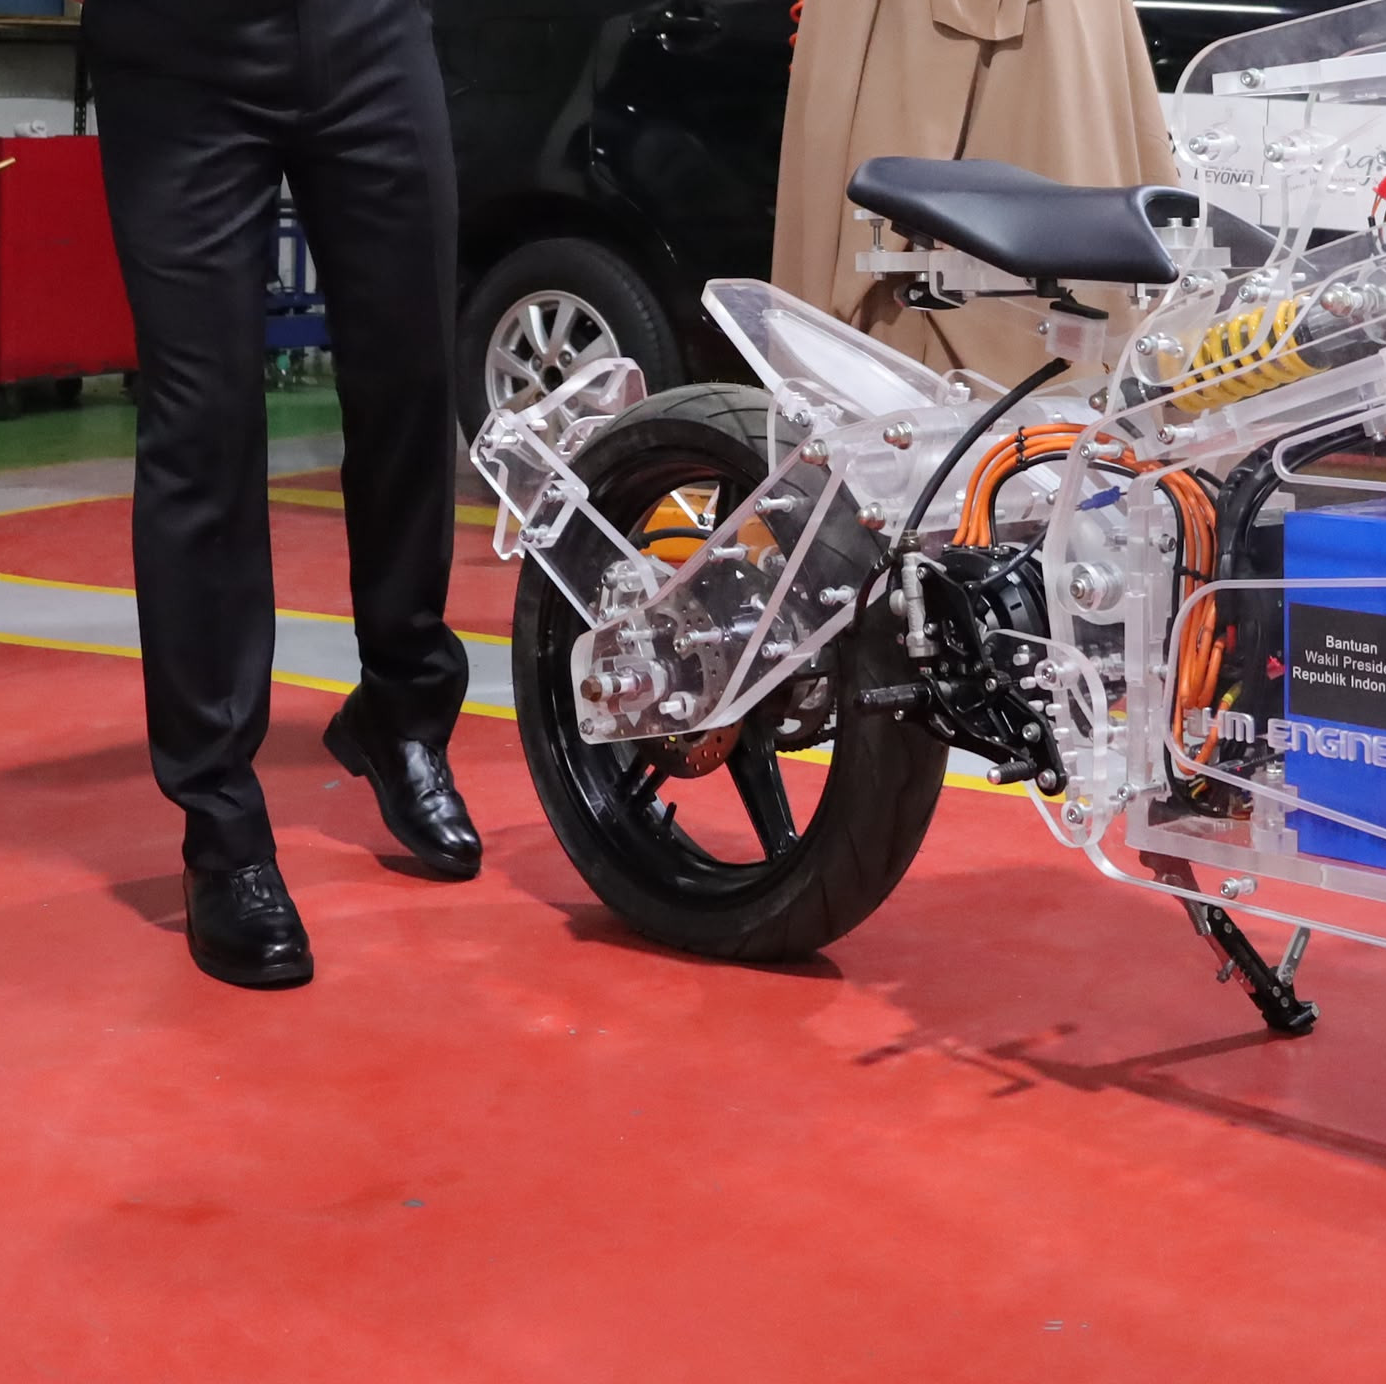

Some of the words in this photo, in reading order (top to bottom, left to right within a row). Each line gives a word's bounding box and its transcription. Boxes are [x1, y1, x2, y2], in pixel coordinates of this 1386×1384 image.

[1325, 634, 1378, 655] Bantuan
[1304, 649, 1339, 667] Wakil
[1292, 666, 1346, 687] Republik
